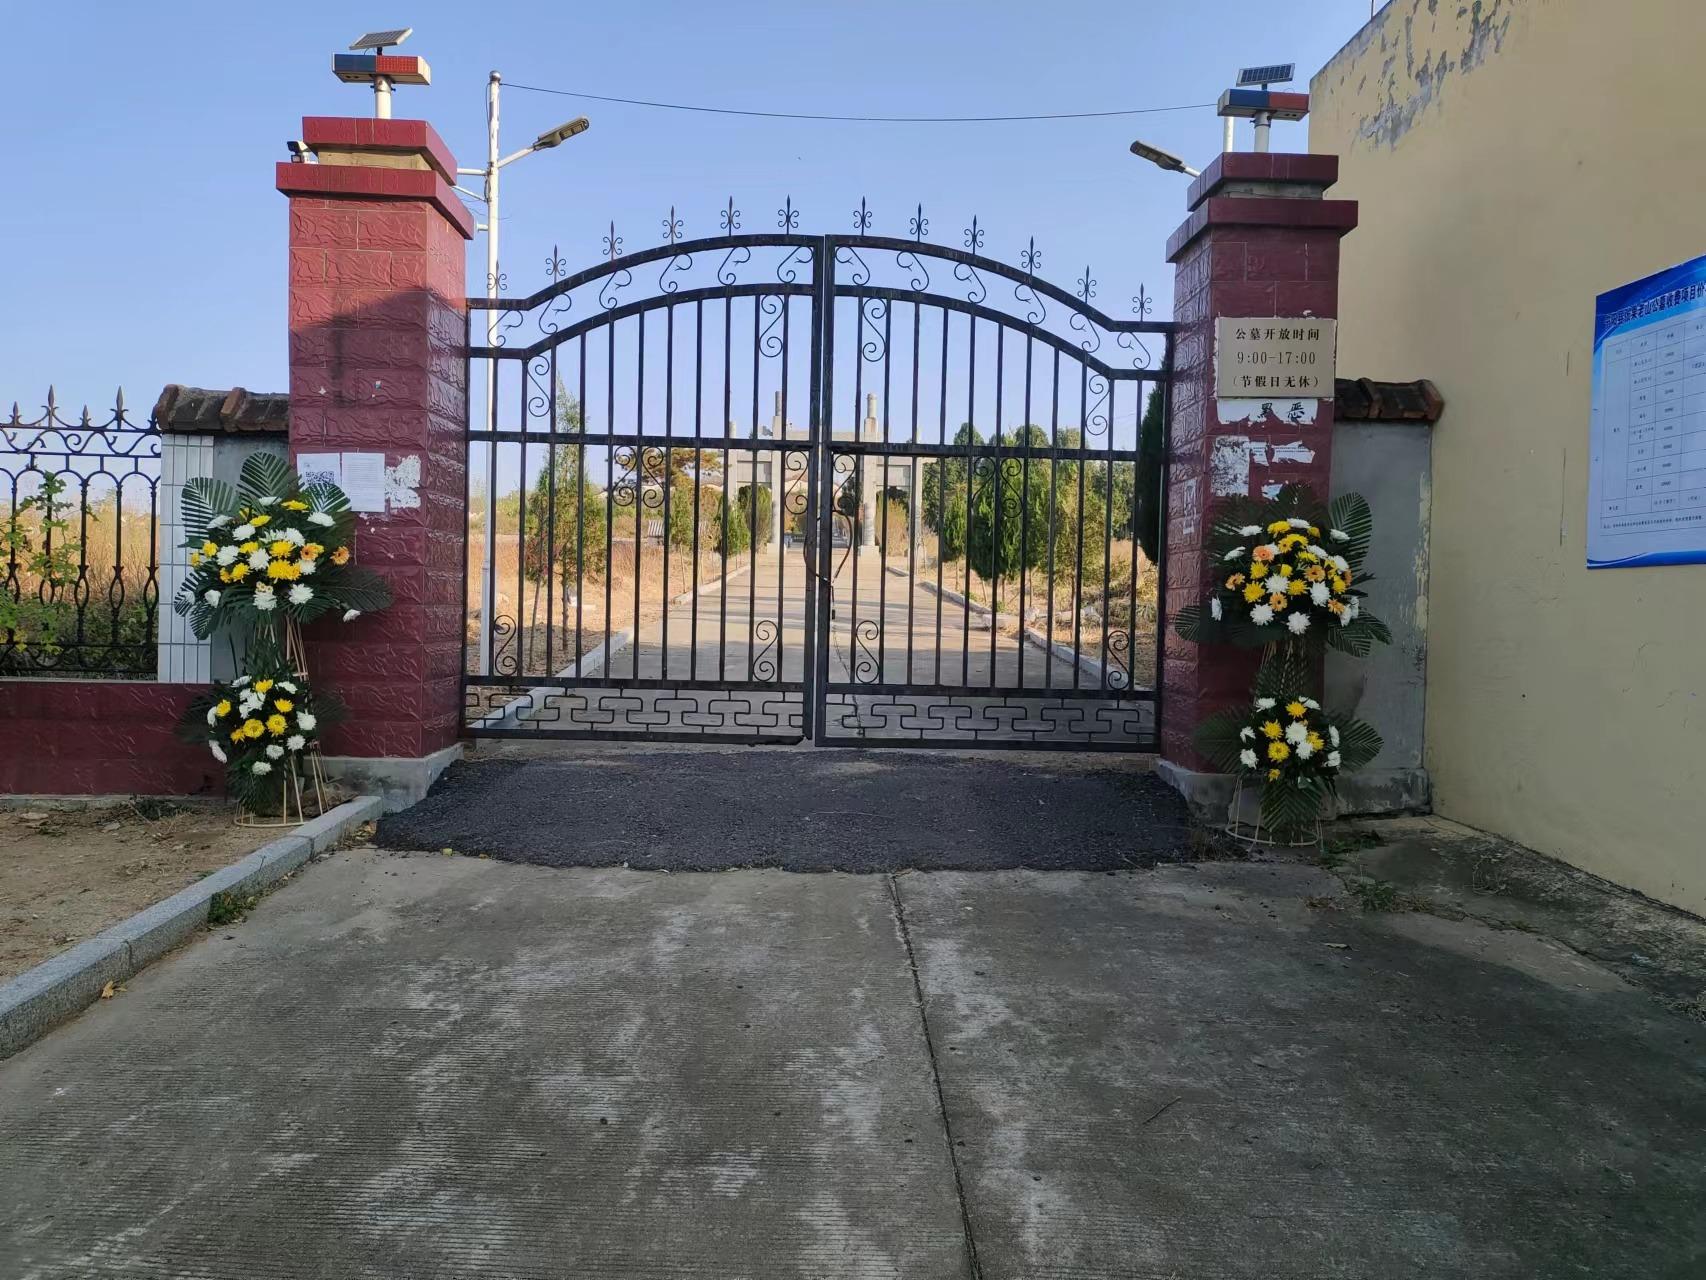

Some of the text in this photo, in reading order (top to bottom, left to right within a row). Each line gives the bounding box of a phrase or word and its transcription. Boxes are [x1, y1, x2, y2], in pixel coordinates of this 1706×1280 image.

[1235, 328, 1320, 341] 公墓开放时间
[1237, 351, 1316, 365] 9:00-17:00
[1233, 375, 1320, 388] （节假日无休）
